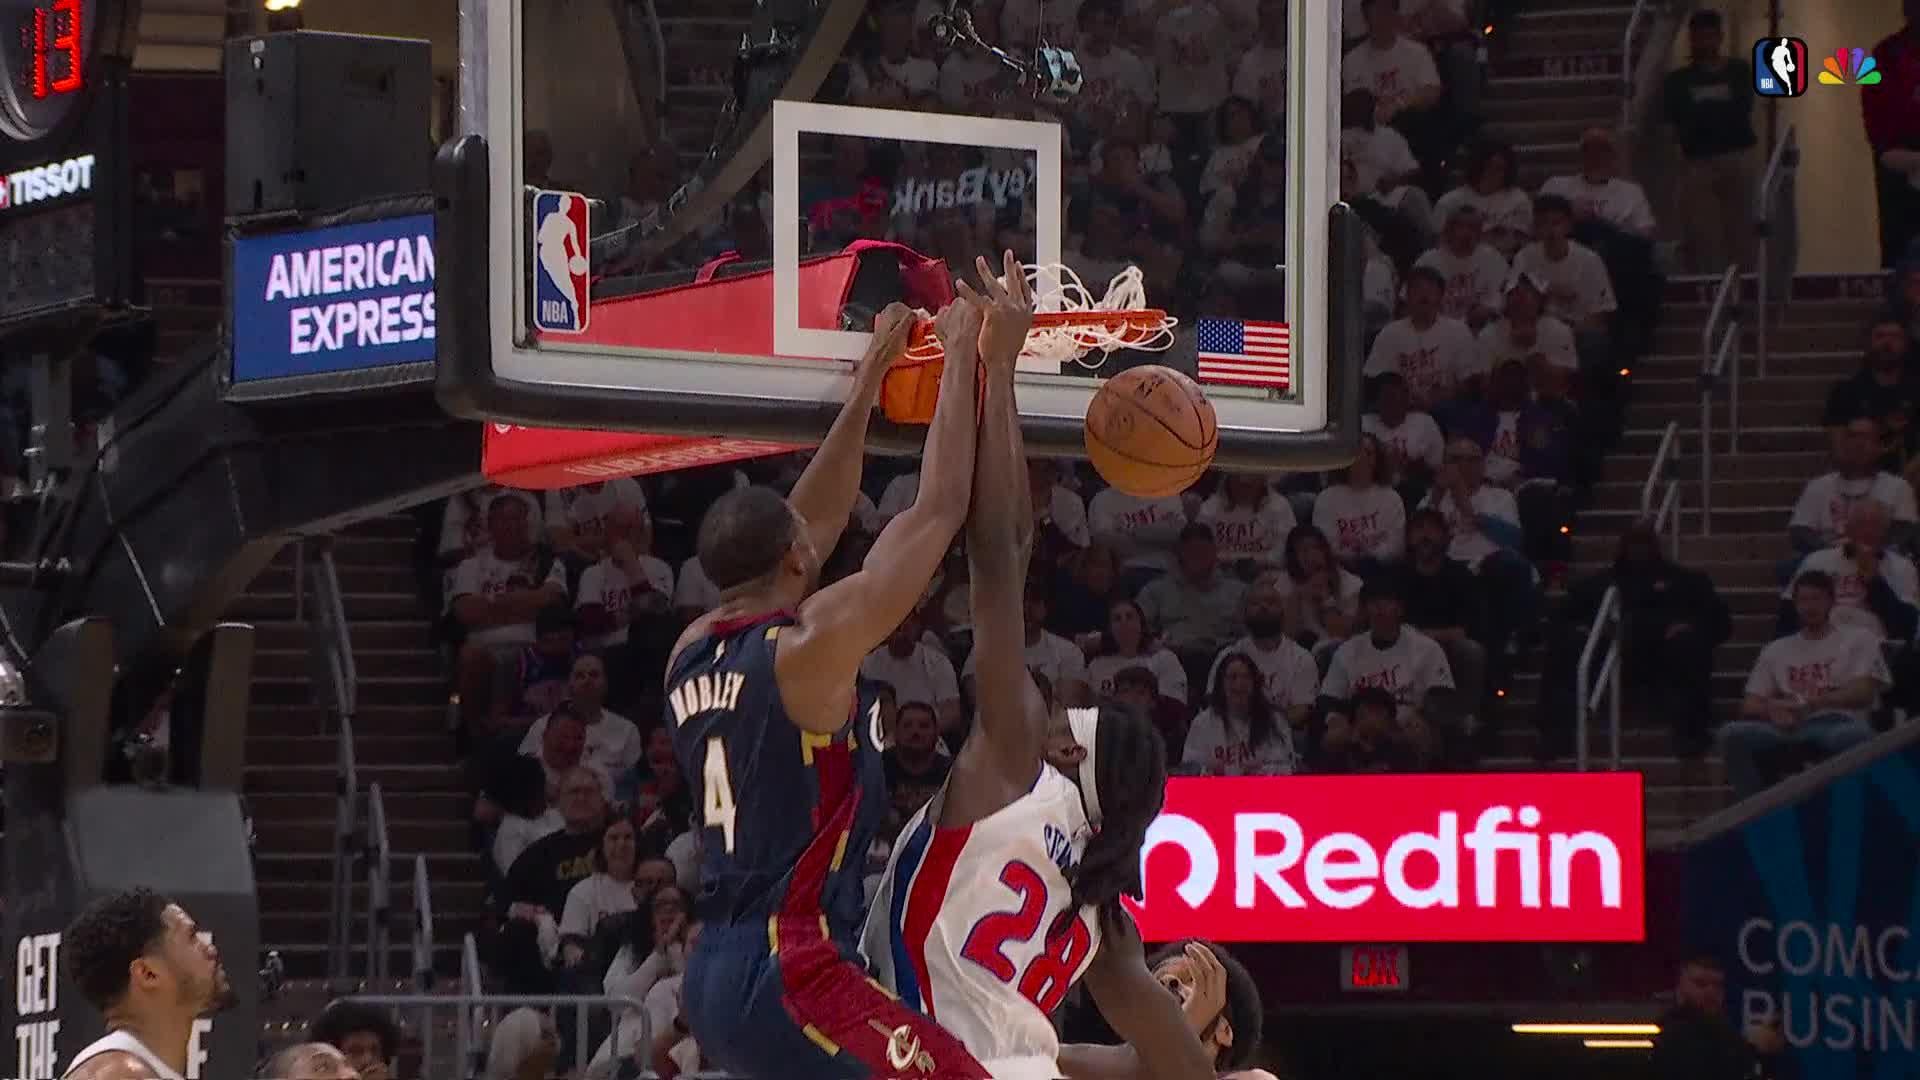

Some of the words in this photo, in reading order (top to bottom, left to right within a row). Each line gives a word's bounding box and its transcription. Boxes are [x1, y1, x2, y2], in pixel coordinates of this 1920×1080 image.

[33, 0, 83, 99] 13
[9, 154, 95, 205] TISSOT
[265, 234, 435, 301] AMERICAN
[289, 290, 435, 355] EXPRESS
[541, 300, 570, 325] NBA
[703, 735, 737, 855] 4
[1234, 805, 1622, 909] Redfin
[960, 859, 1092, 1016] 28
[1737, 916, 1920, 983] COMC
[16, 931, 62, 1017] GET
[15, 1018, 61, 1080] THE
